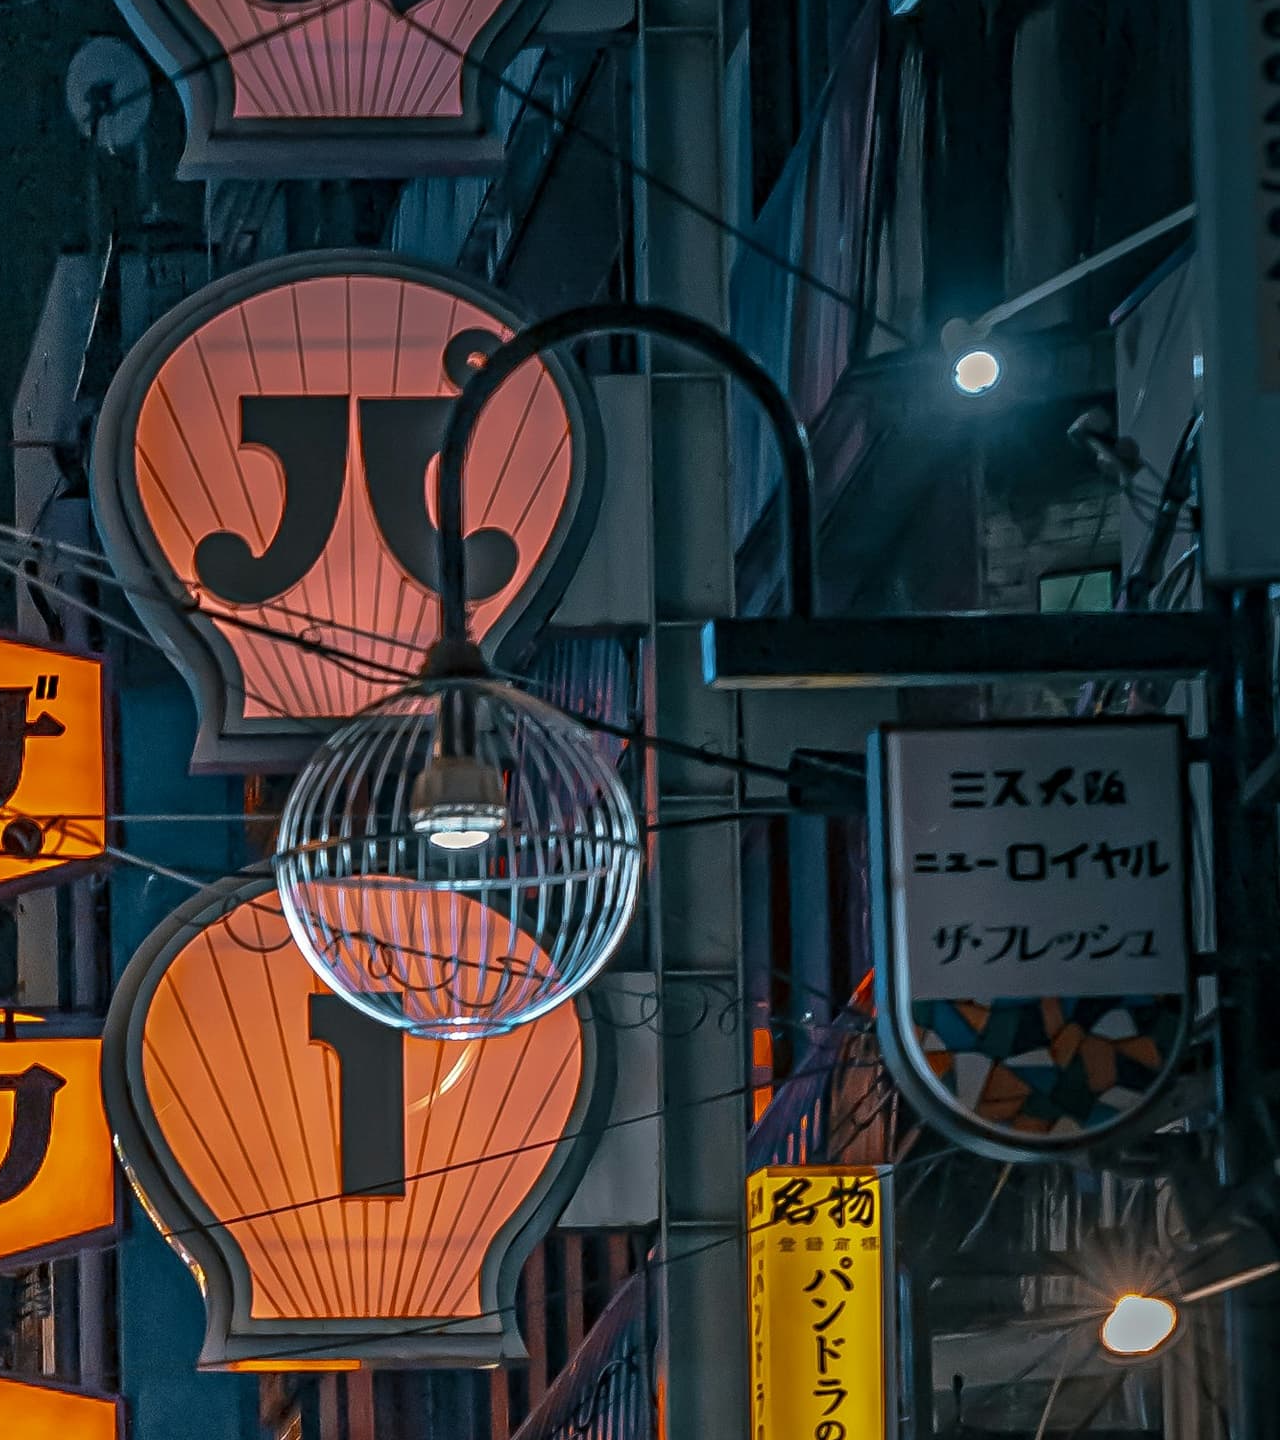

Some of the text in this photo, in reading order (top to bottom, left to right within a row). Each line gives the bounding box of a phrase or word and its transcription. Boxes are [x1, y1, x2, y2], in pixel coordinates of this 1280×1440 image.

[913, 839, 1170, 883] ニューロイヤル
[771, 1177, 876, 1230] 名物
